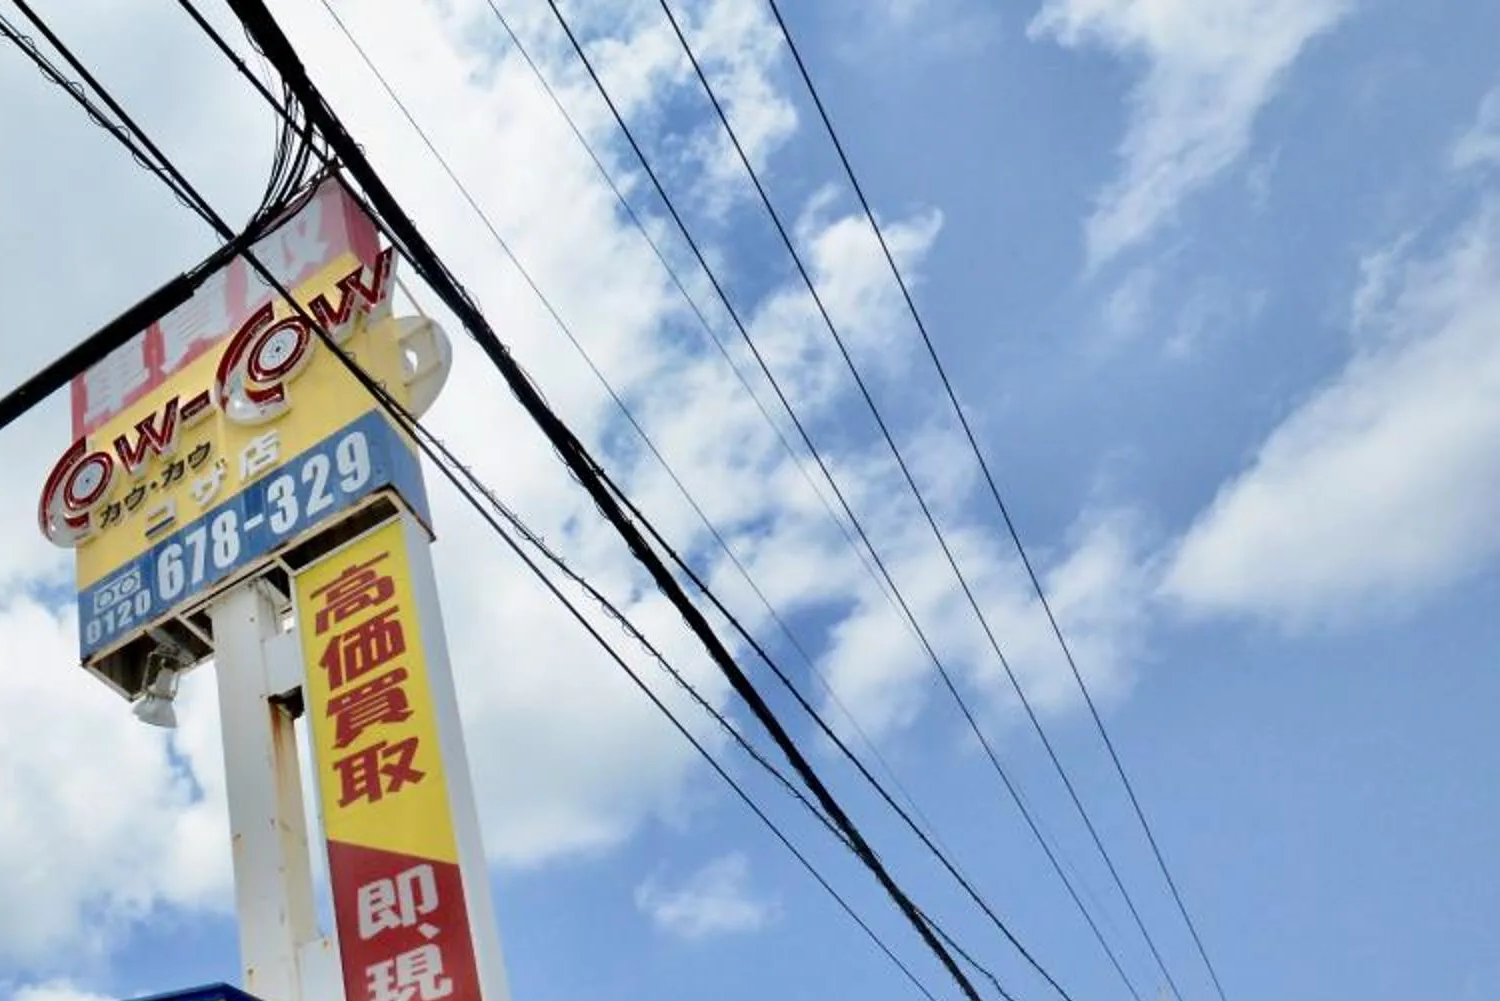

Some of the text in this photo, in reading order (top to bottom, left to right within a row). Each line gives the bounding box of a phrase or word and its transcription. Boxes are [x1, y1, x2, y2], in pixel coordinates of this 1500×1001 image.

[86, 431, 371, 645] 0120 678-329
[310, 551, 426, 808] 高価買取
